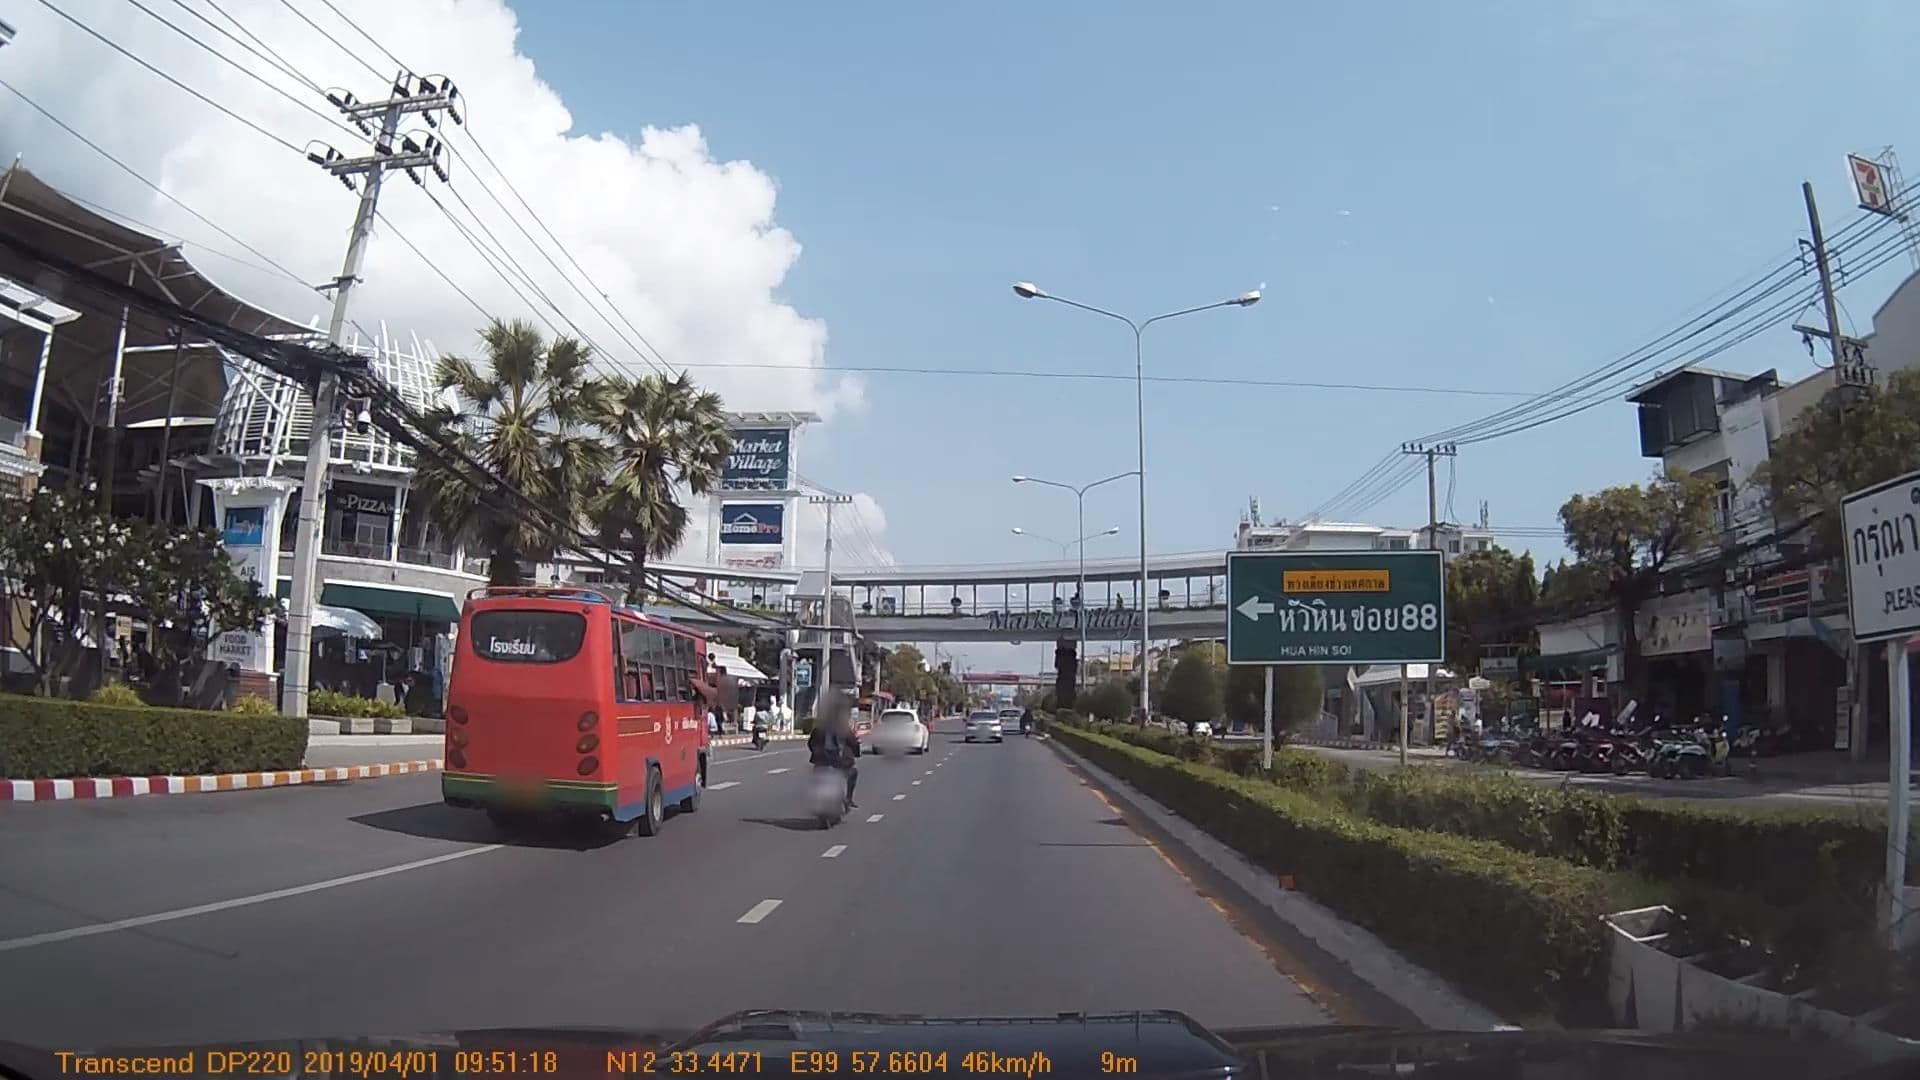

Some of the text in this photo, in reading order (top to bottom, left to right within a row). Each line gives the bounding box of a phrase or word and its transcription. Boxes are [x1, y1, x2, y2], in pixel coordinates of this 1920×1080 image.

[729, 438, 783, 454] Market
[727, 454, 783, 475] Village
[347, 494, 388, 514] PIZZA
[721, 522, 779, 534] HomePro
[240, 565, 256, 577] AIS
[988, 607, 1145, 640] Market Village
[224, 634, 247, 644] FOOD
[490, 636, 536, 655] โรงเรียน
[219, 645, 251, 656] MARKET
[1280, 645, 1352, 656] HUA HIN SOI
